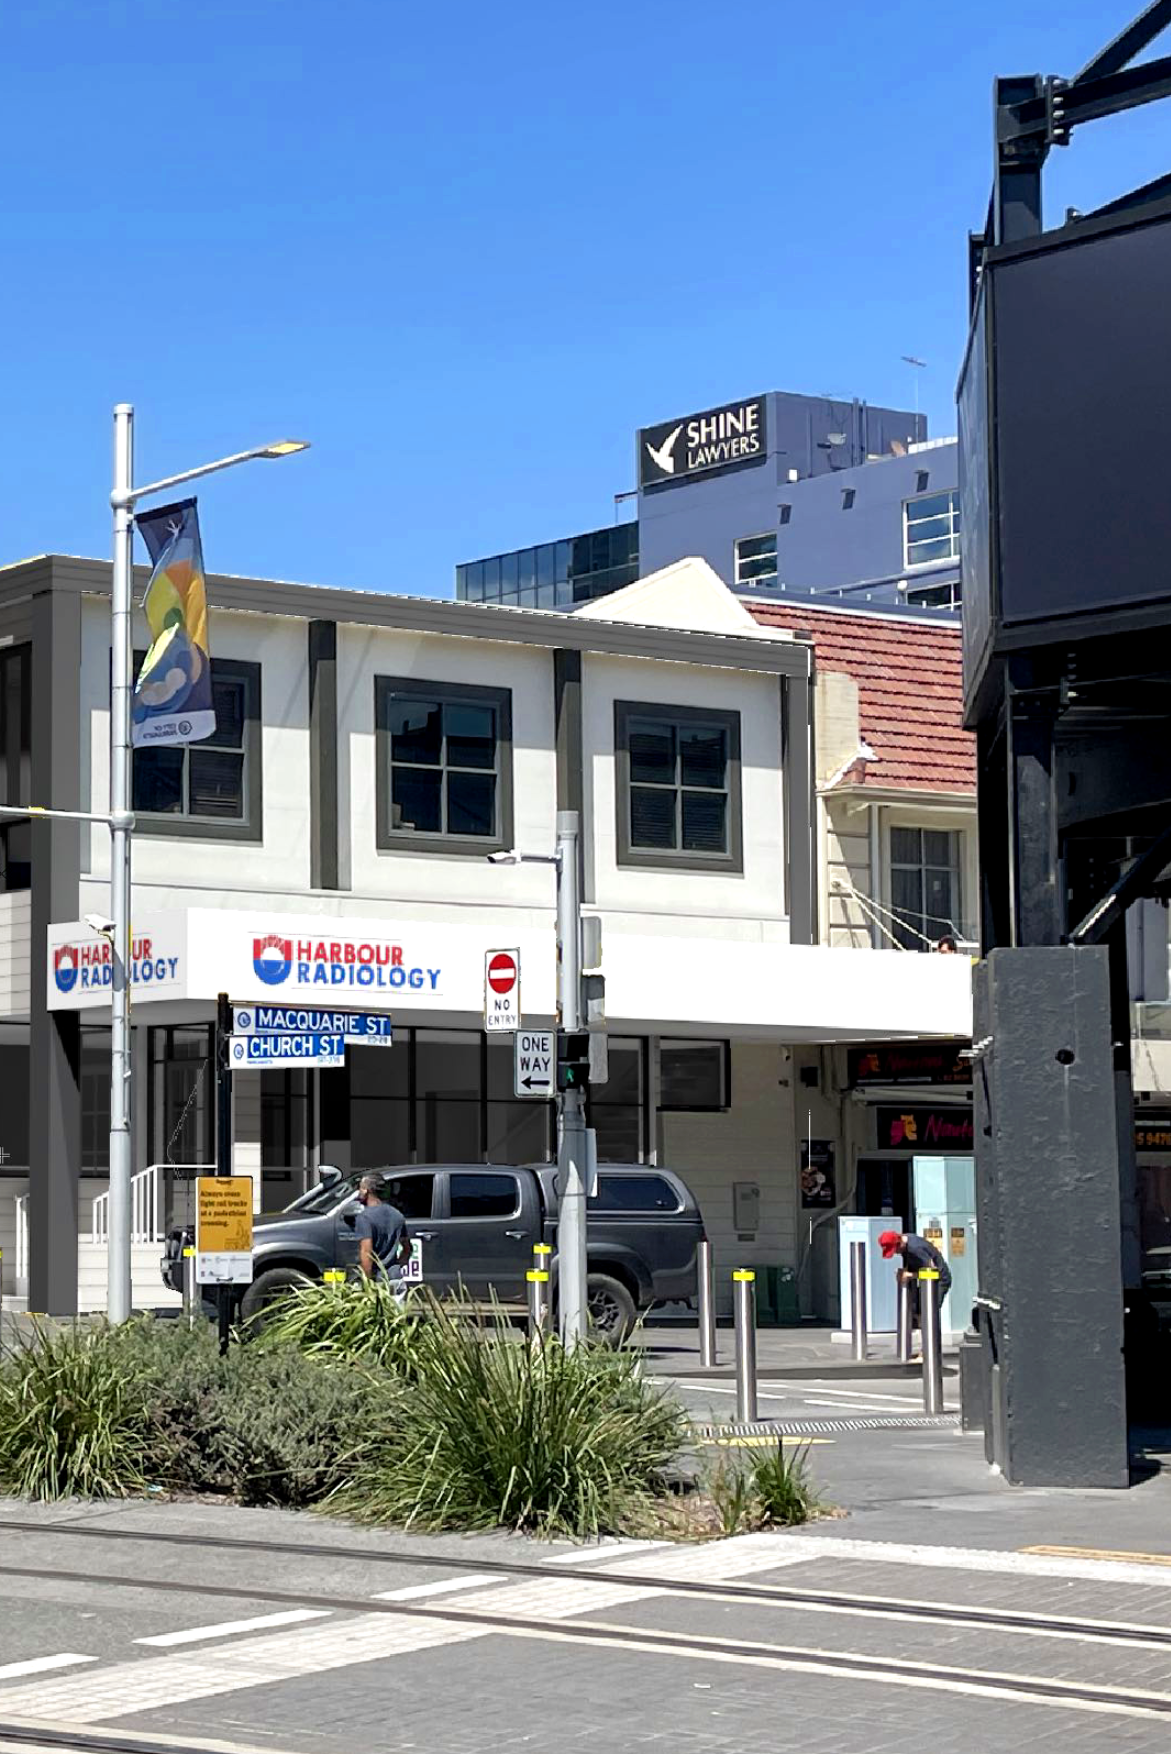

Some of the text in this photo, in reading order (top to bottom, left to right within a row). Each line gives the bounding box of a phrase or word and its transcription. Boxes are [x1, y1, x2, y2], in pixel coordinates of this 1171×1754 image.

[687, 404, 759, 447] SHINE
[687, 433, 760, 469] LAWYERS
[81, 938, 152, 966] HARUR
[297, 939, 404, 966] HARBOUR
[81, 957, 178, 988] RADLOGY
[297, 962, 441, 990] RADIOLOGY
[494, 999, 510, 1010] NO
[258, 1008, 388, 1034] MACQUARIE ST
[488, 1014, 516, 1025] ENTRY
[250, 1032, 341, 1056] CHURCH ST
[522, 1037, 549, 1051] ONE
[520, 1057, 551, 1072] WAY
